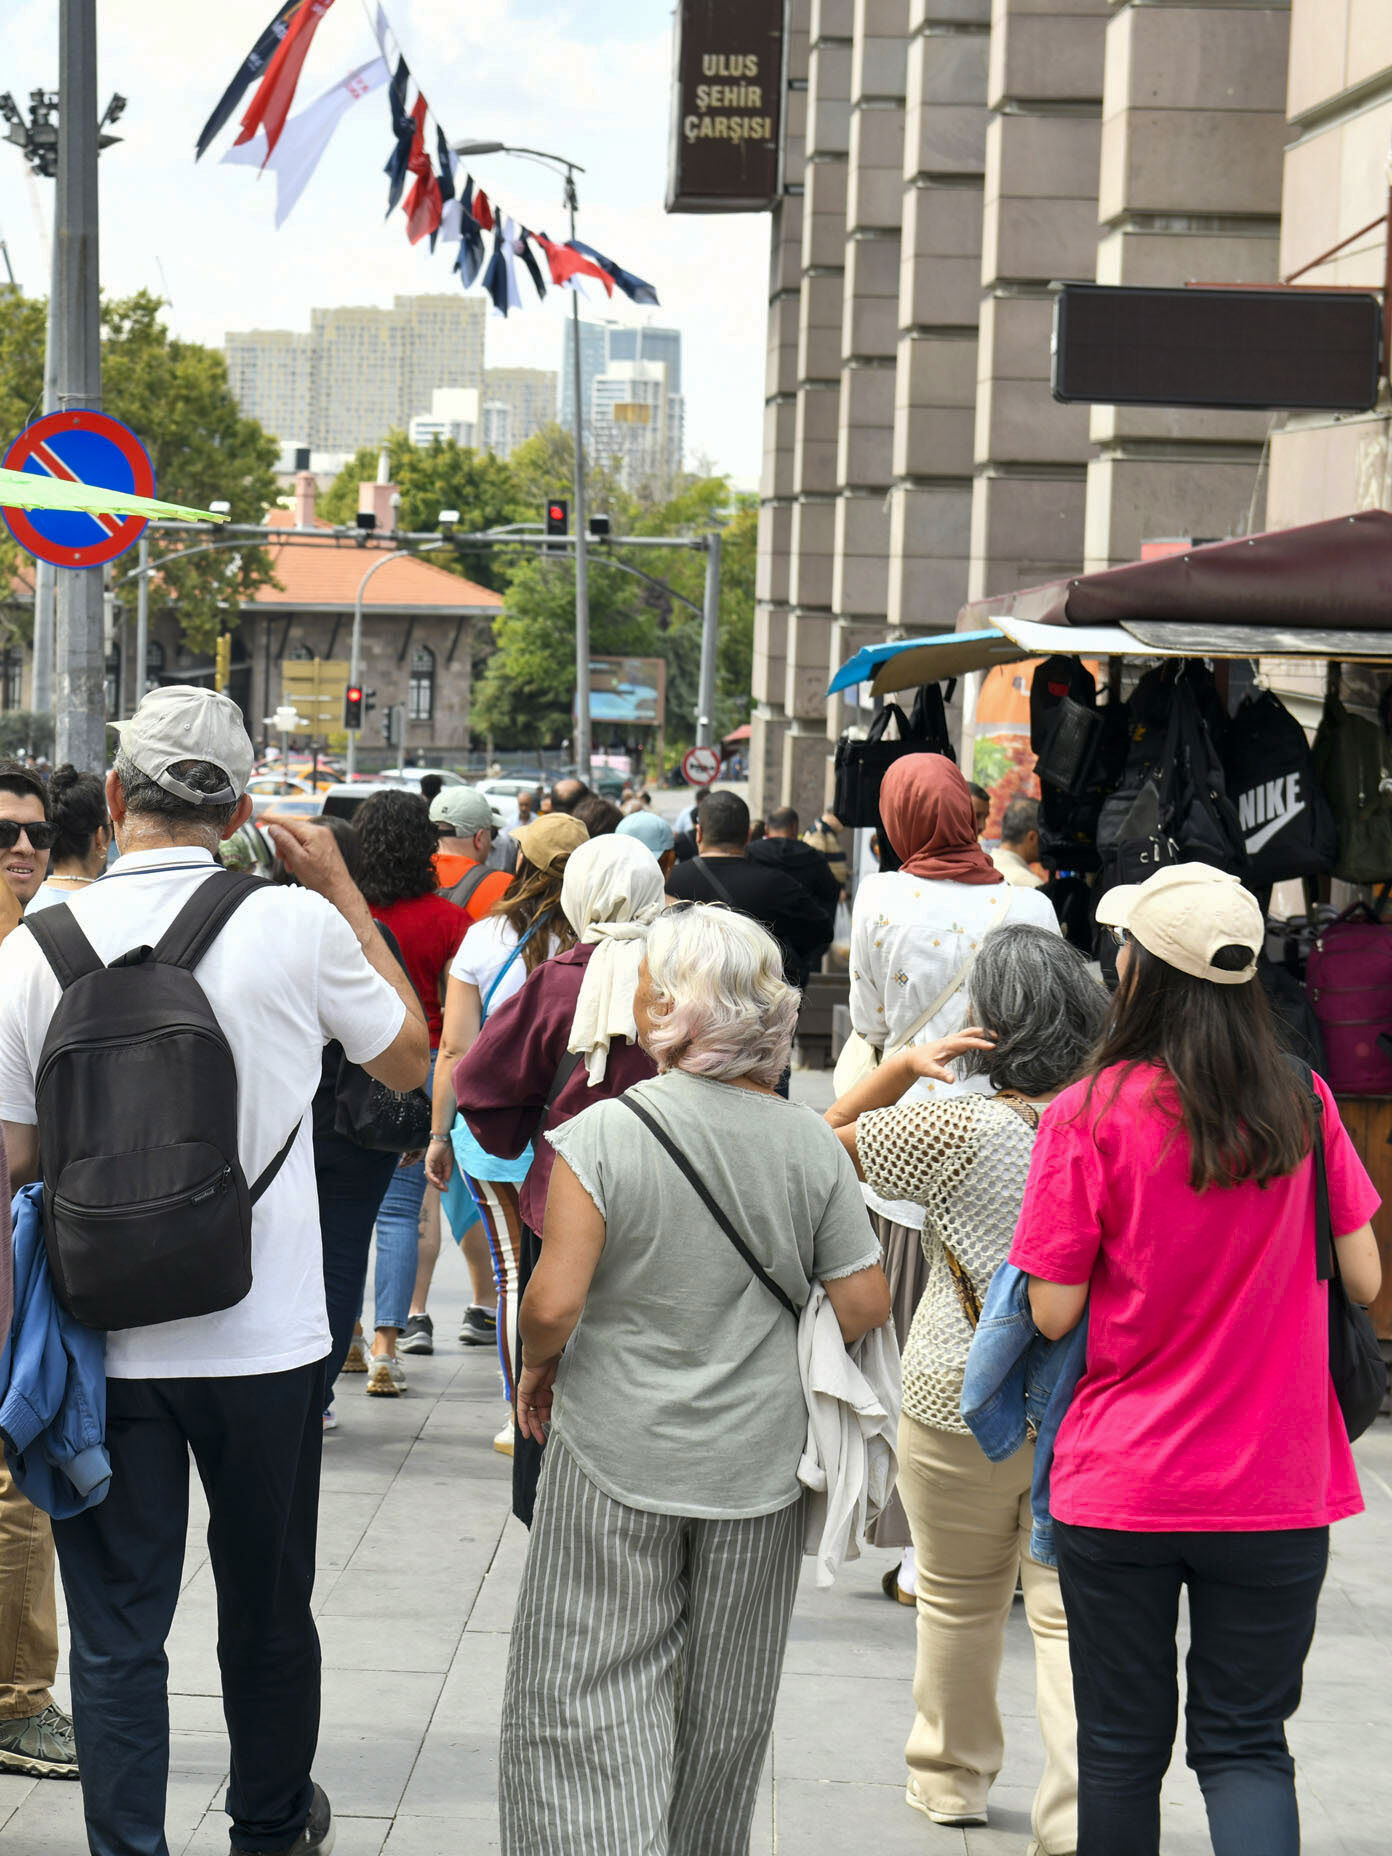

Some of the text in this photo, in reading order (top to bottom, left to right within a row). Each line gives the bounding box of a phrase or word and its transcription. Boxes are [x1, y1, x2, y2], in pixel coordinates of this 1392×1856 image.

[702, 54, 759, 77] ULUS
[696, 81, 763, 113] ŞEHİR
[684, 114, 772, 144] ÇARŞISI
[1238, 771, 1303, 832] NIKE
